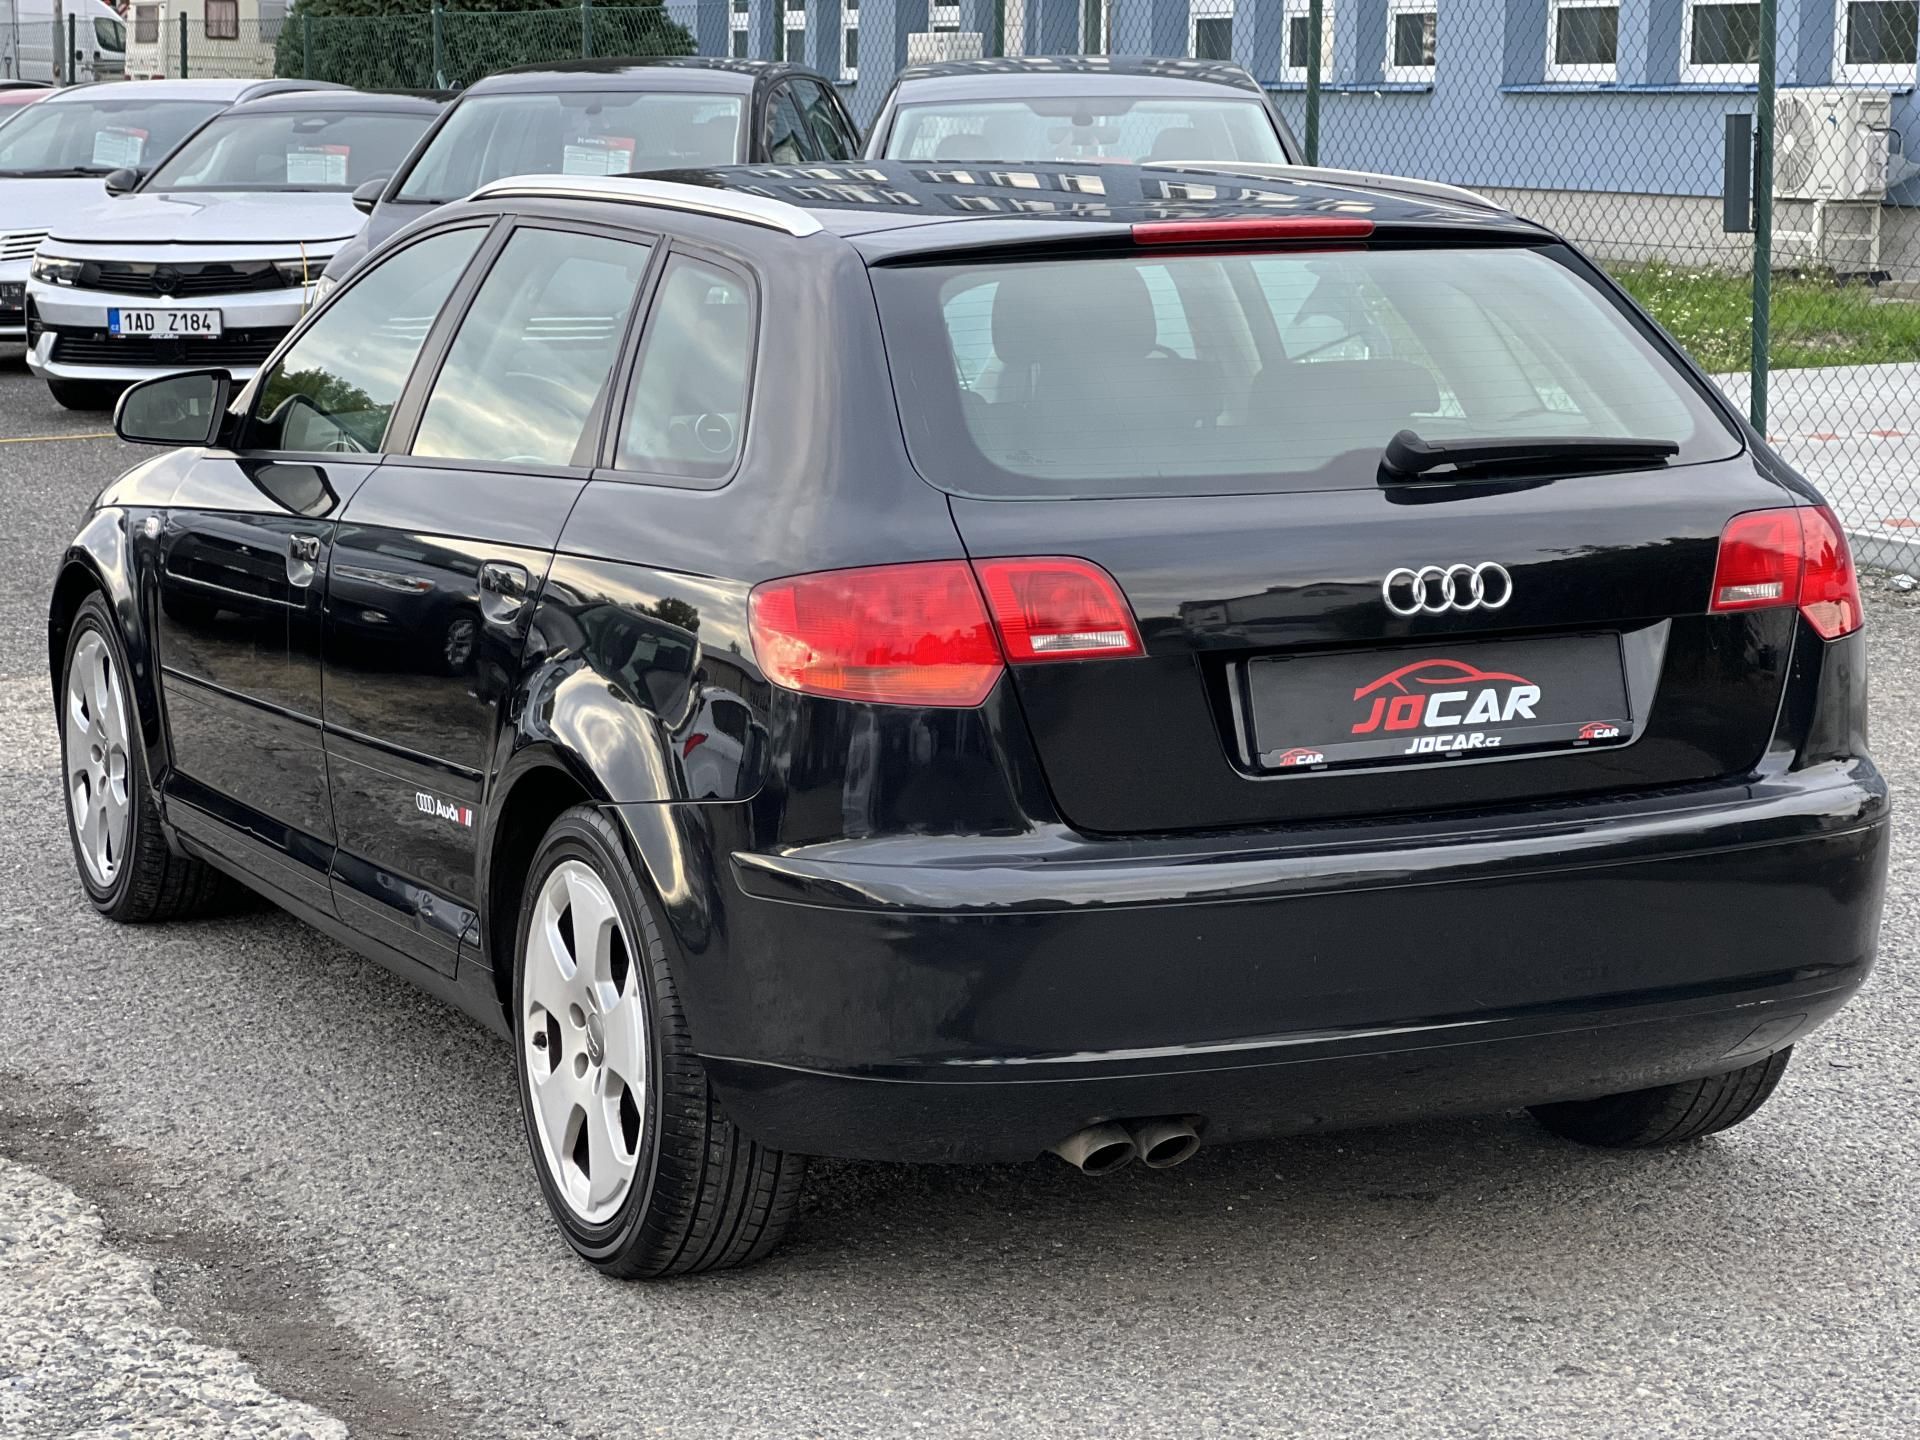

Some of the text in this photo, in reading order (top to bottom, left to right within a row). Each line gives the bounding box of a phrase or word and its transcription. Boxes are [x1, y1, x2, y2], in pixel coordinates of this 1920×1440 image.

[124, 313, 212, 332] 1AD Z184
[1351, 685, 1541, 734] JOCAR
[1578, 727, 1620, 739] JOCAR
[1279, 753, 1324, 766] JOCAR
[435, 799, 459, 822] Audi
